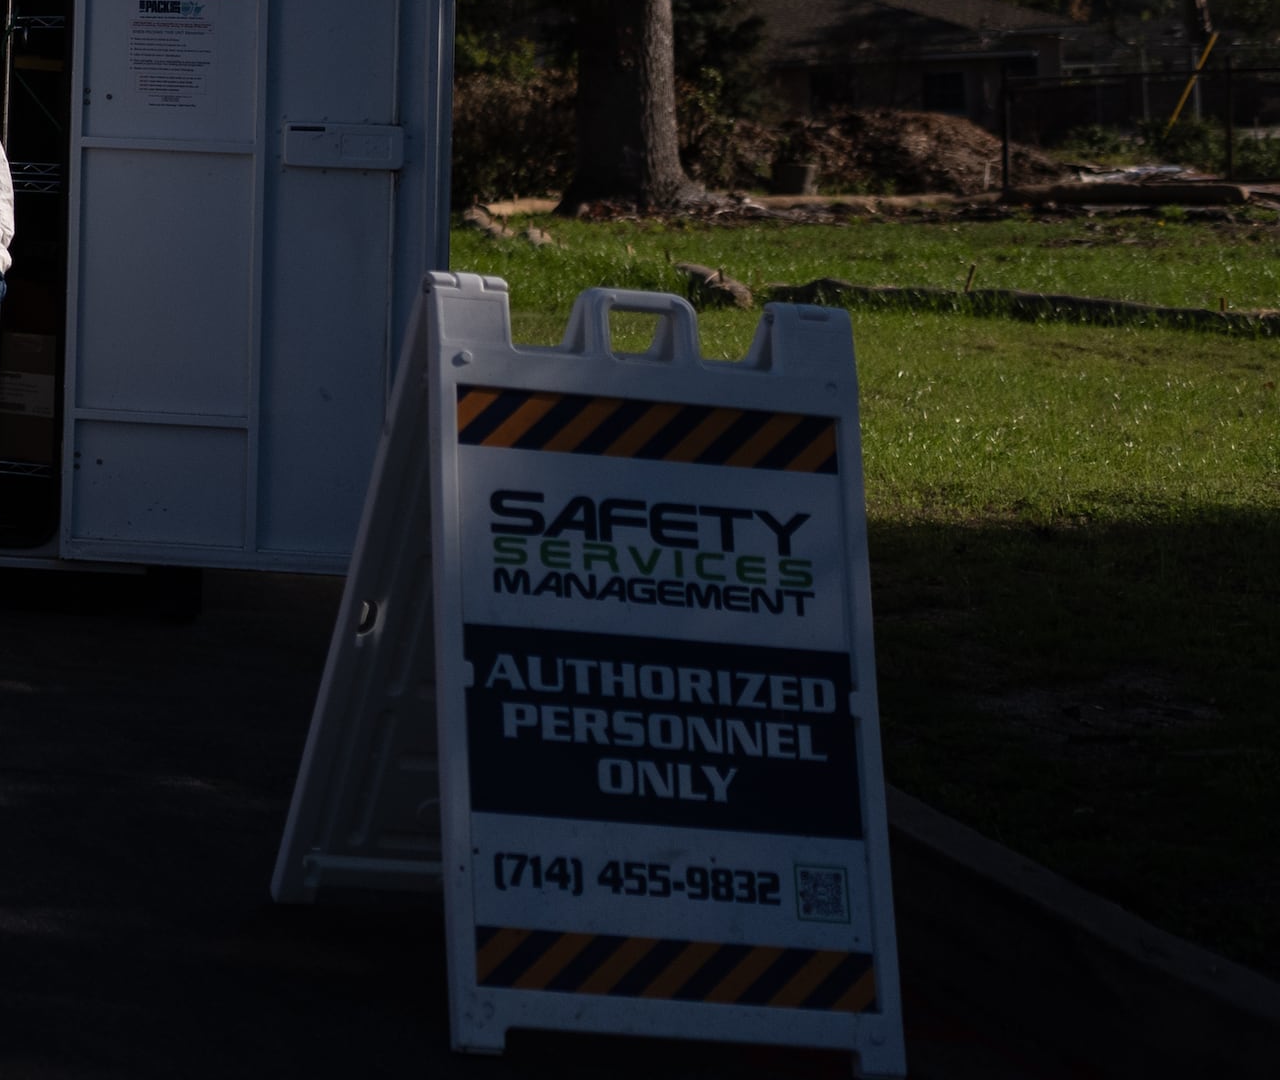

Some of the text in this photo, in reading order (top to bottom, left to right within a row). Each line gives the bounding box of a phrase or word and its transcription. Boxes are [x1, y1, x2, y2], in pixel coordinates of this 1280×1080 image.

[490, 489, 811, 557] SAFETY
[493, 536, 813, 588] SERVICES
[493, 567, 815, 617] MANAGEMENT
[485, 653, 836, 714] AUTHORIZED
[501, 701, 828, 762] PERSONNEL
[597, 757, 738, 803] ONLY
[493, 851, 782, 906] (714) 455-9832
